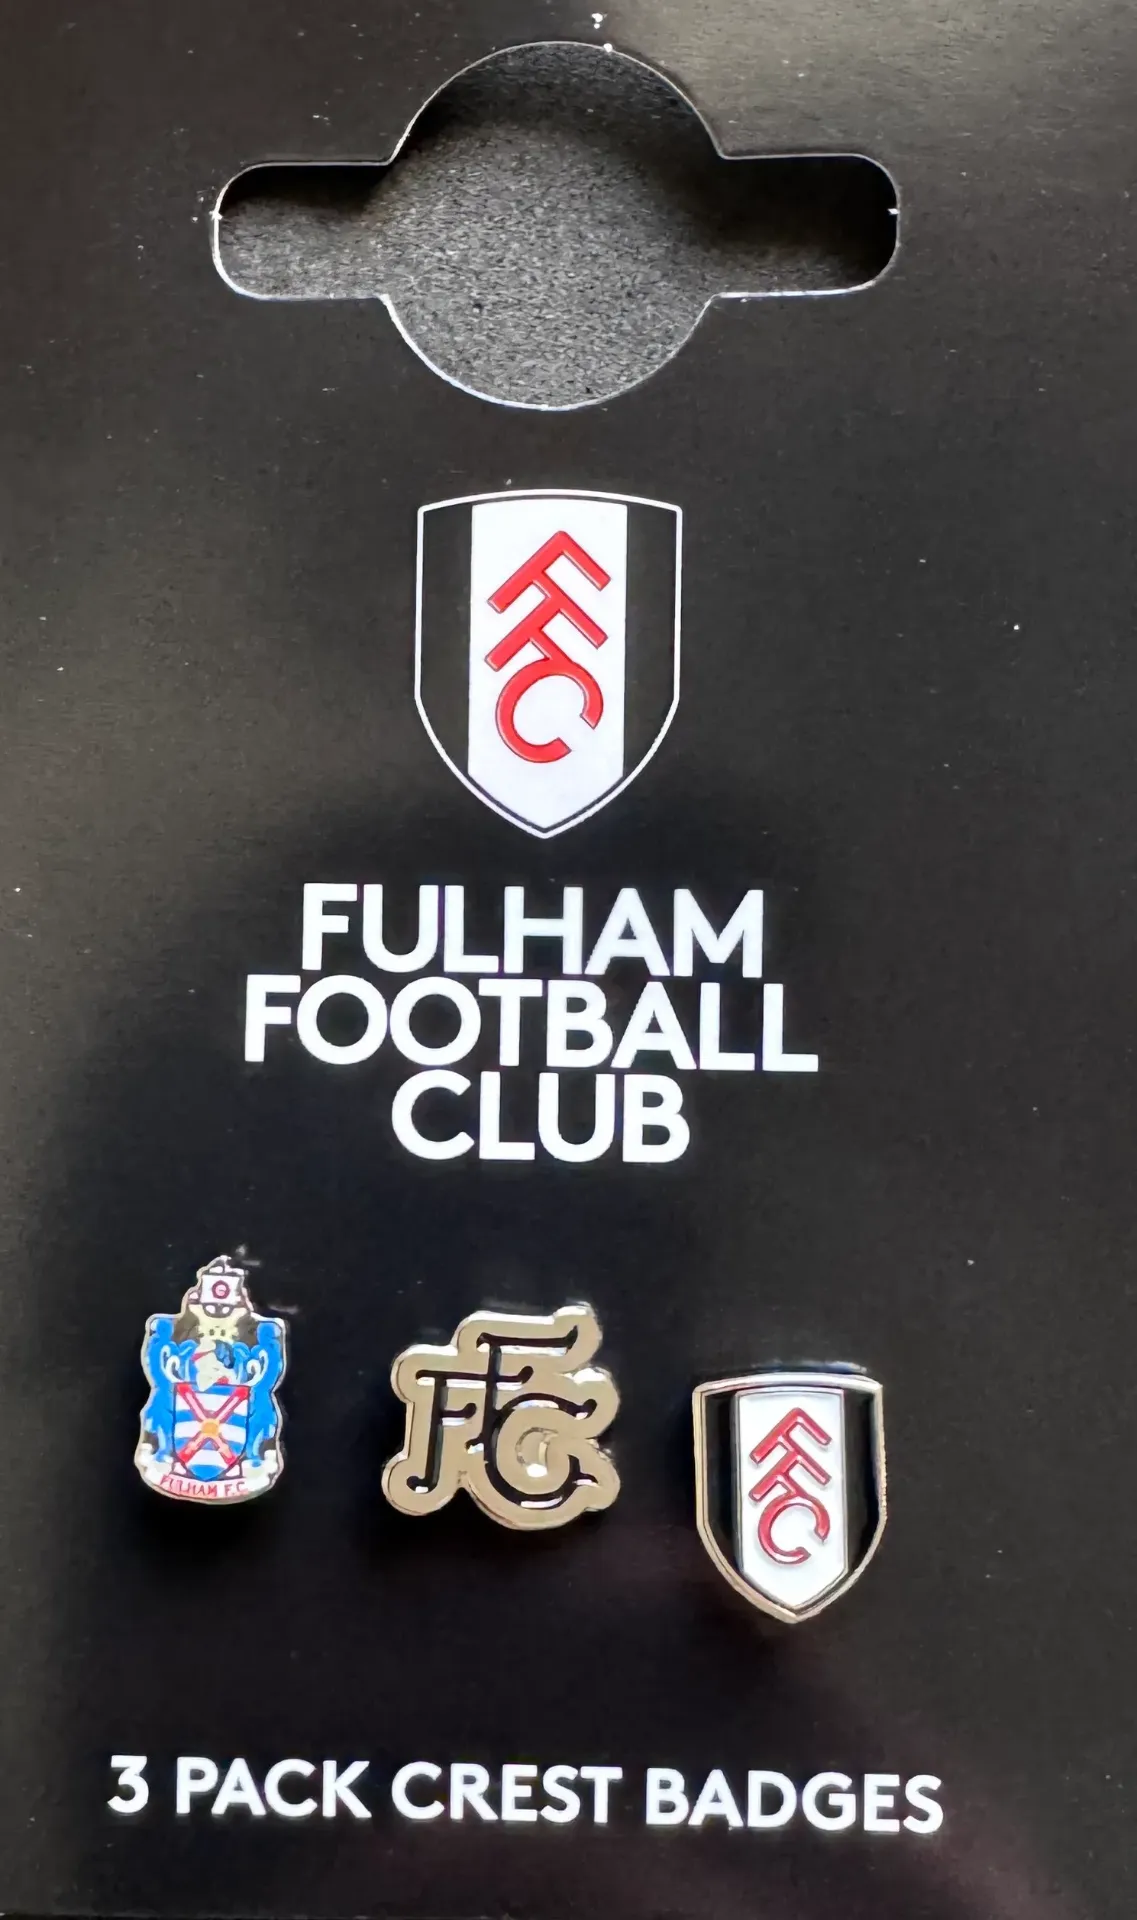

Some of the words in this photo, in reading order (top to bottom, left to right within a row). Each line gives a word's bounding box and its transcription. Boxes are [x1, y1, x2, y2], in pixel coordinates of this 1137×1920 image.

[302, 883, 764, 979] FULHAM
[245, 975, 819, 1073] FOOTBALL
[391, 1069, 691, 1164] CLUB
[107, 1754, 149, 1814] 3
[176, 1756, 372, 1819] PACK
[391, 1761, 623, 1824] CREST
[645, 1767, 944, 1835] BADGES
